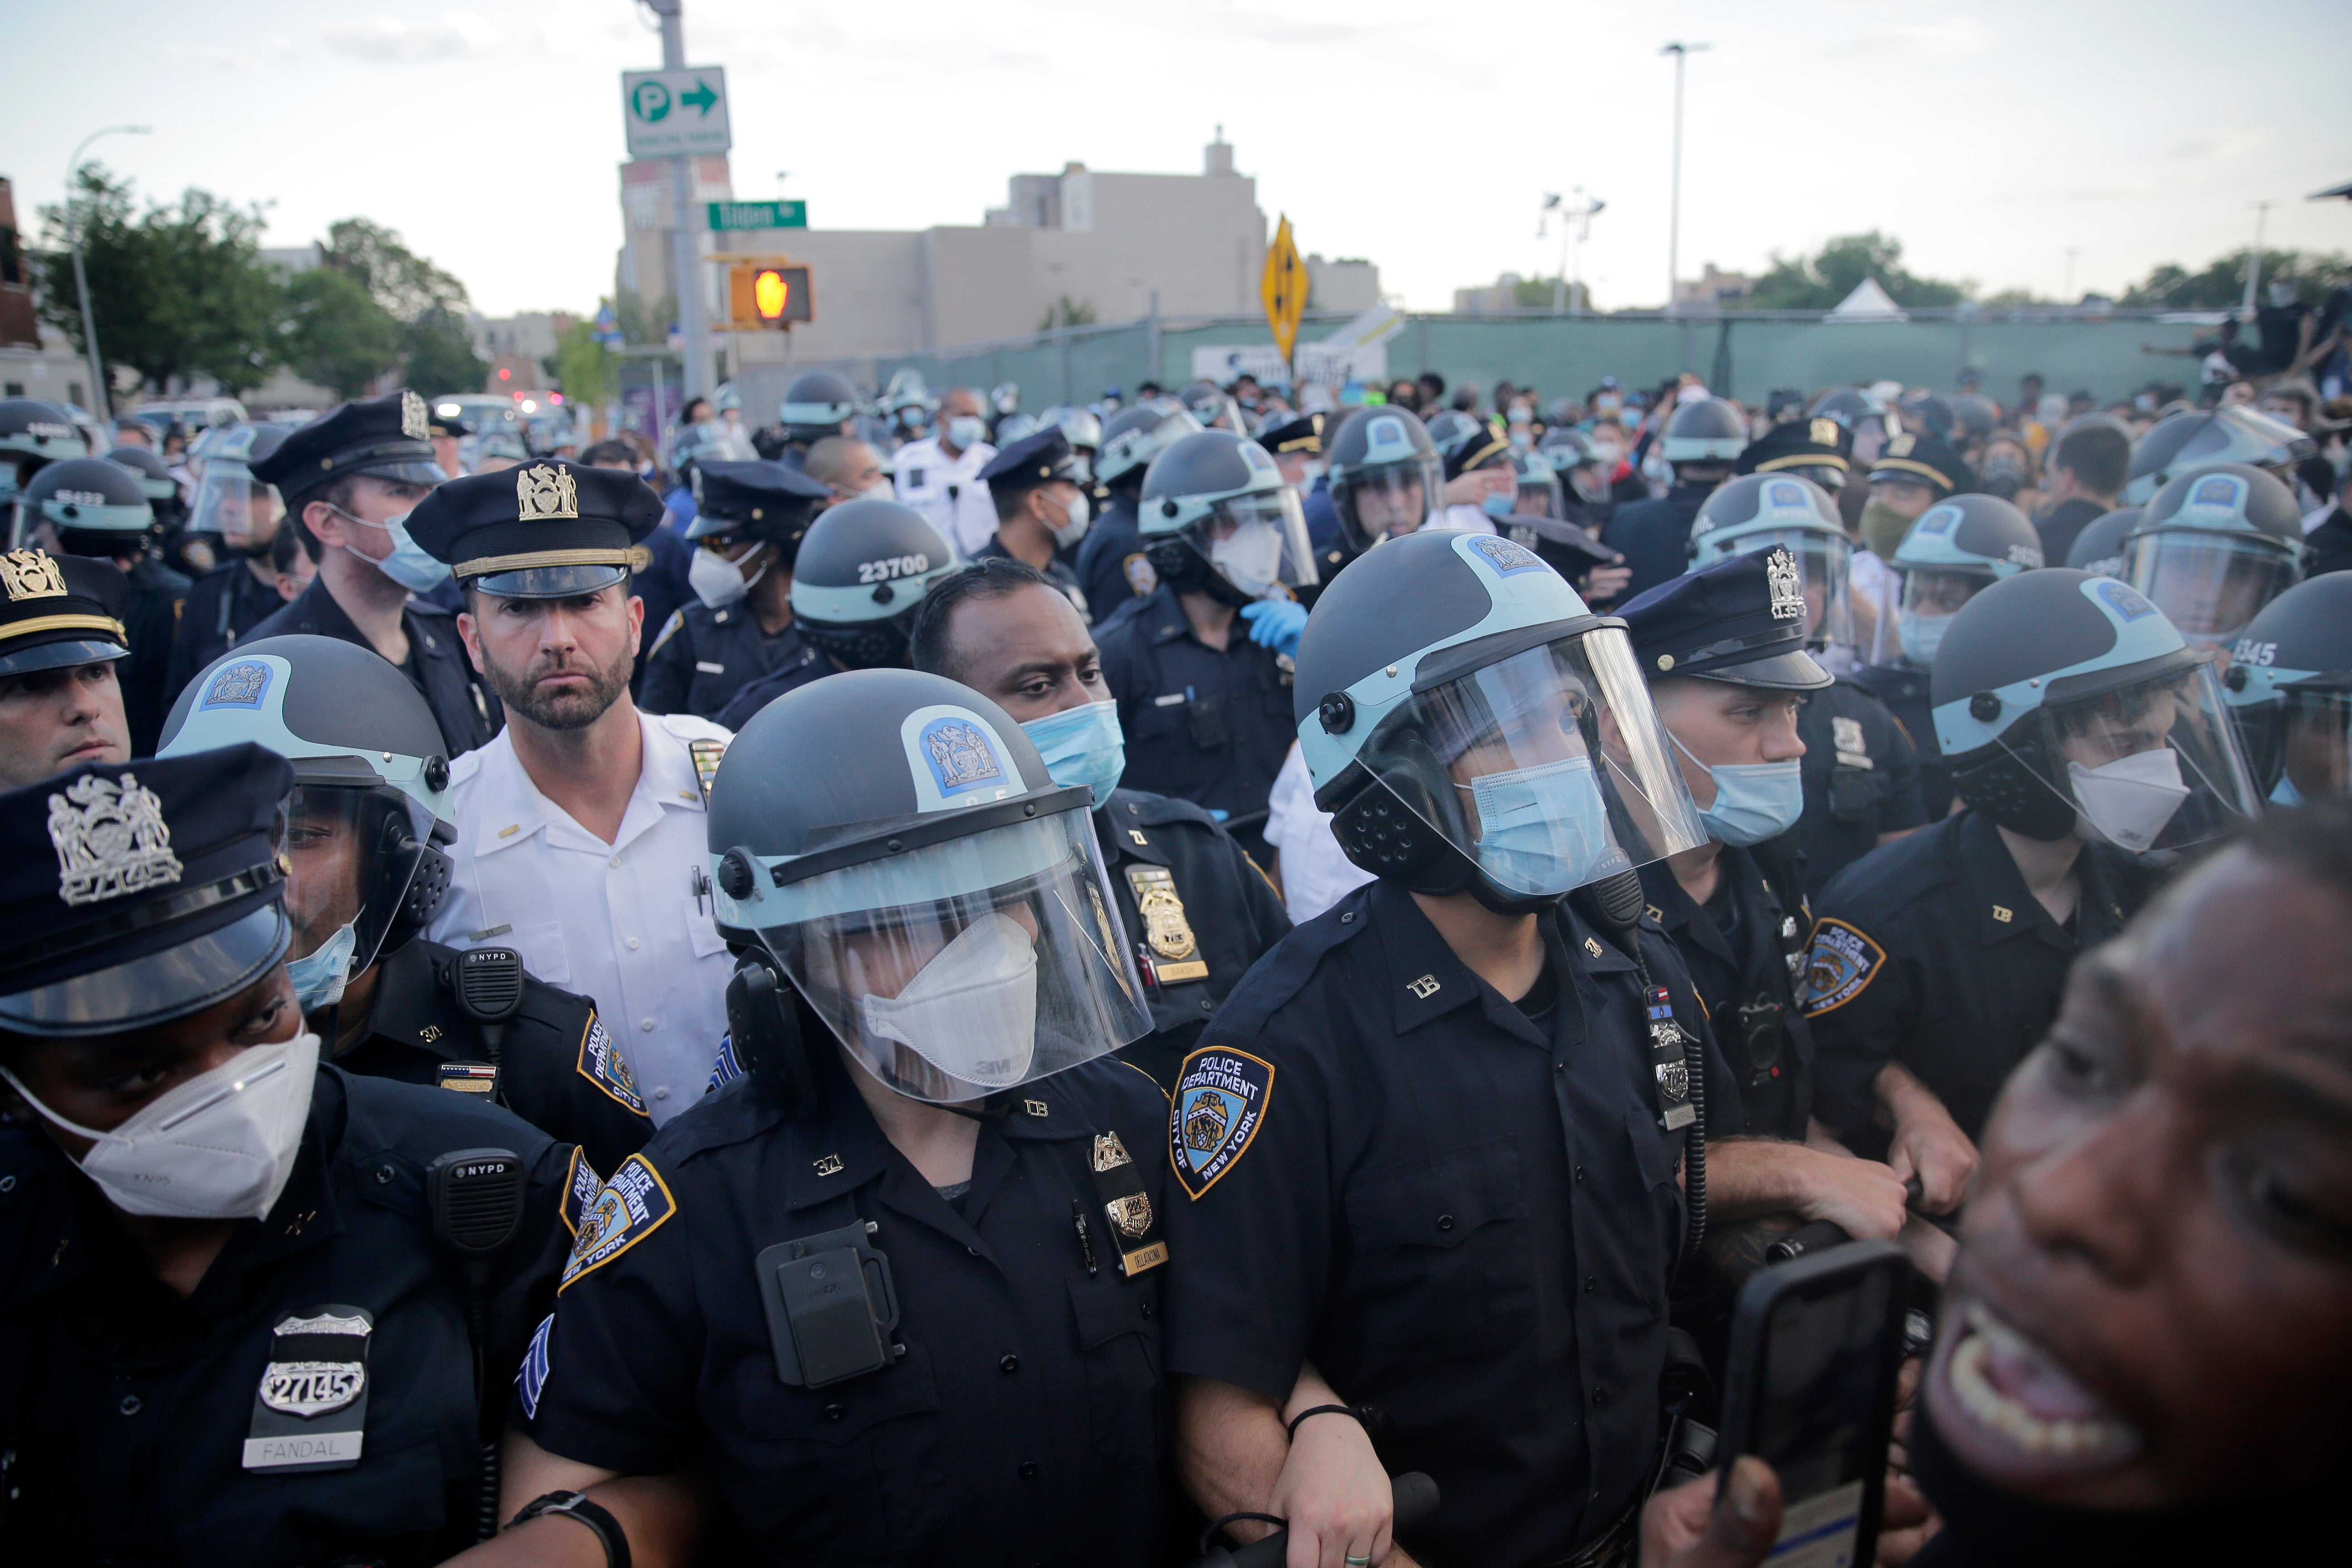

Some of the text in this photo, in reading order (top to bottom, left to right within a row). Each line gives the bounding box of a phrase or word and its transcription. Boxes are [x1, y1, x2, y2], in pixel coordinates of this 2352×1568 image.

[858, 553, 929, 583] 23700
[1601, 856, 1621, 869] NYPD
[1814, 933, 1872, 973] DEPARTMENT
[1829, 926, 1865, 953] POLICE
[1835, 977, 1864, 1000] YORK
[1199, 1057, 1243, 1076] POLICE
[613, 1086, 632, 1103] CITY
[1181, 1071, 1259, 1100] DEPARTMENT
[1172, 1109, 1187, 1169] CITY OF
[1202, 1111, 1257, 1180] NEW YORK
[469, 1164, 504, 1175] NYPD
[626, 1162, 654, 1198] POLICE
[586, 1234, 626, 1264] YORK
[274, 1371, 351, 1404] 27145
[262, 1440, 340, 1460] FANDAL
